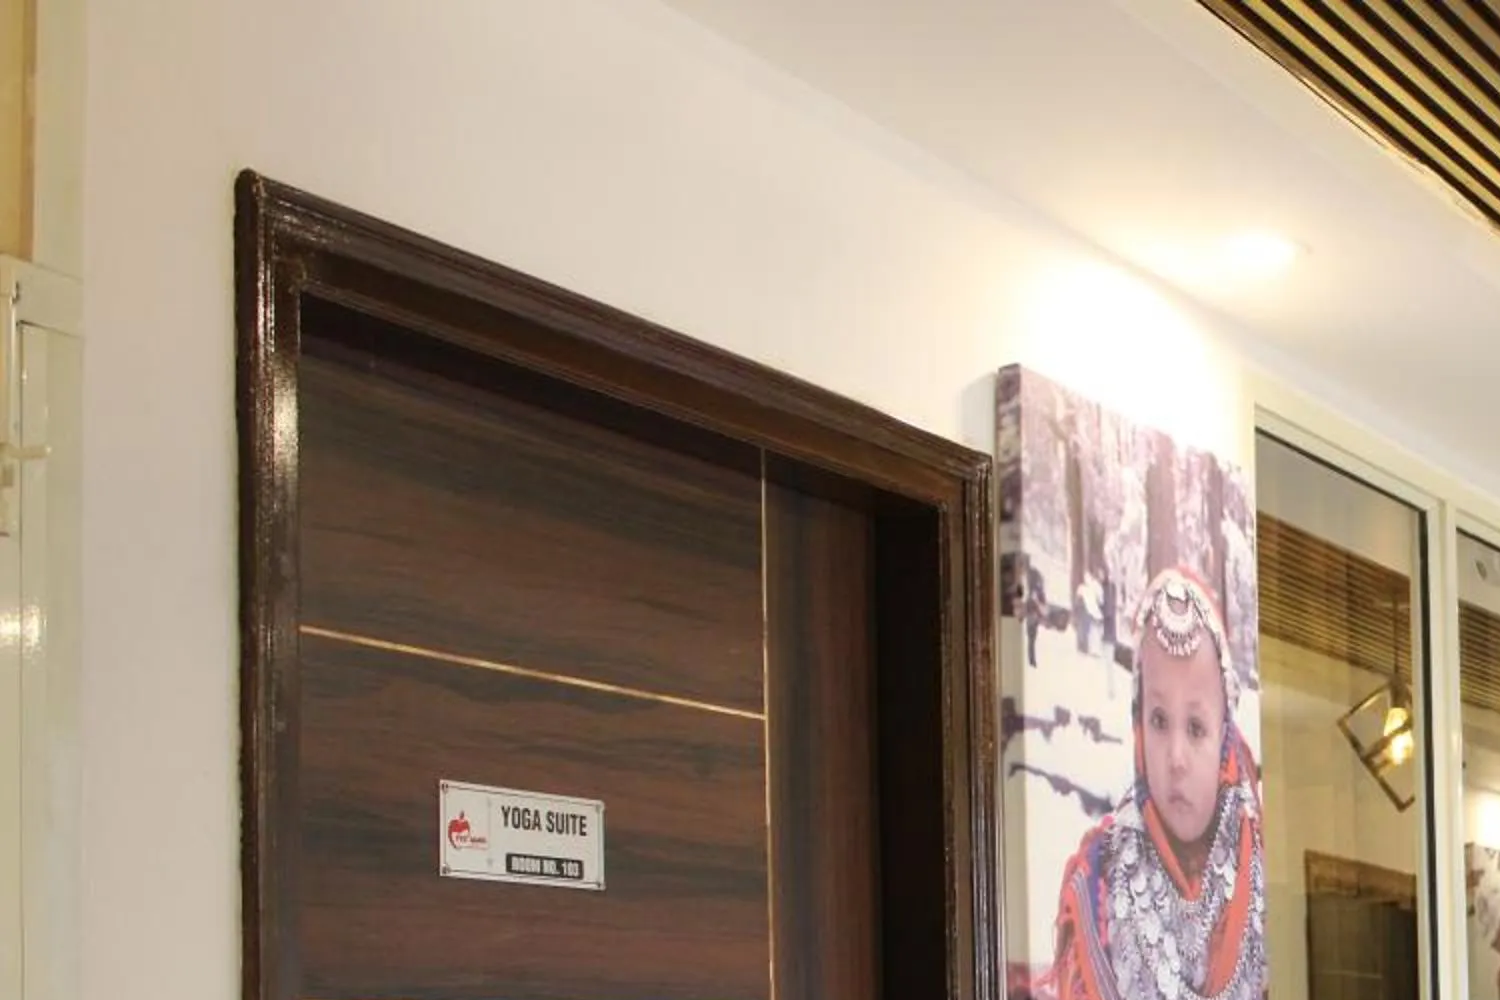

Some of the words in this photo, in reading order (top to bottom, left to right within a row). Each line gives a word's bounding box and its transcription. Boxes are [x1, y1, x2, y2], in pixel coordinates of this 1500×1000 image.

[501, 805, 542, 832] YOGA
[546, 810, 588, 837] SUITE
[511, 855, 541, 874] ROOM
